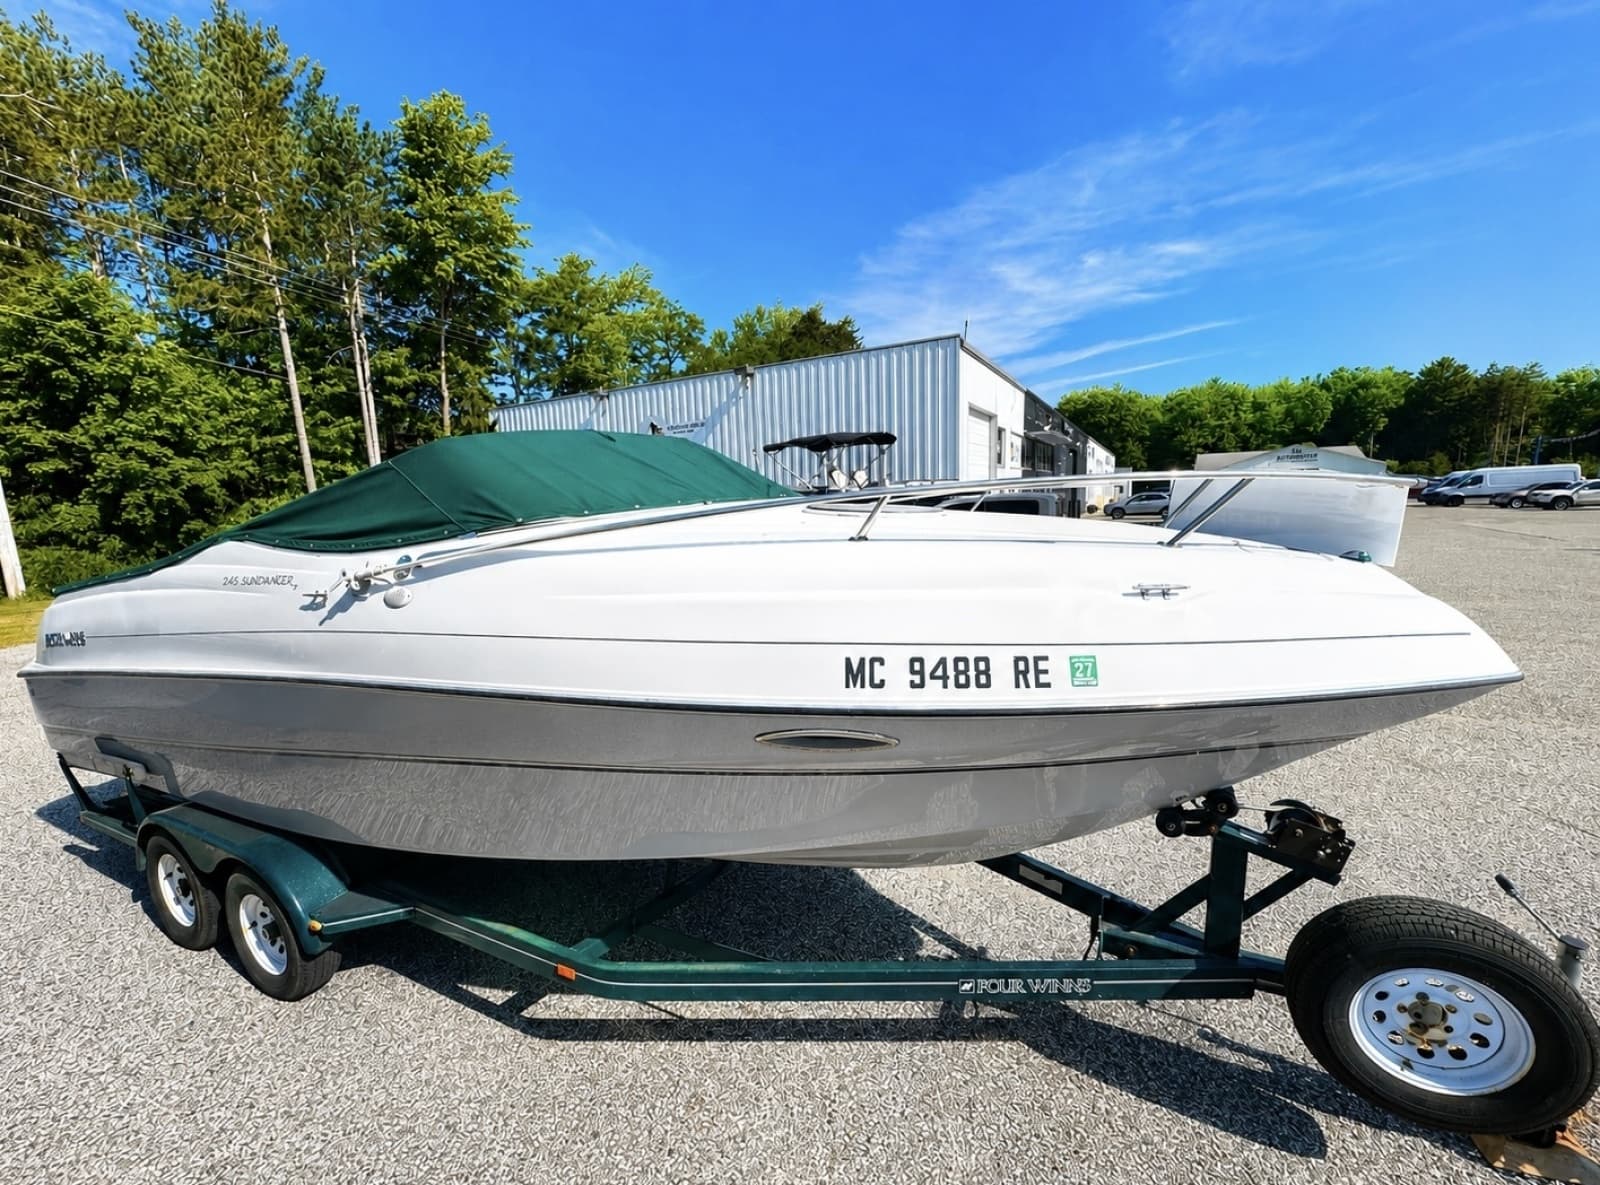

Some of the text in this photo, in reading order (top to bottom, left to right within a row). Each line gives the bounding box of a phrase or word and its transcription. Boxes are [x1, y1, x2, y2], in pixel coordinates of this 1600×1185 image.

[845, 656, 1052, 689] MC 9488 RE
[1074, 662, 1093, 678] 27
[976, 978, 1092, 994] FOUR WINNS
